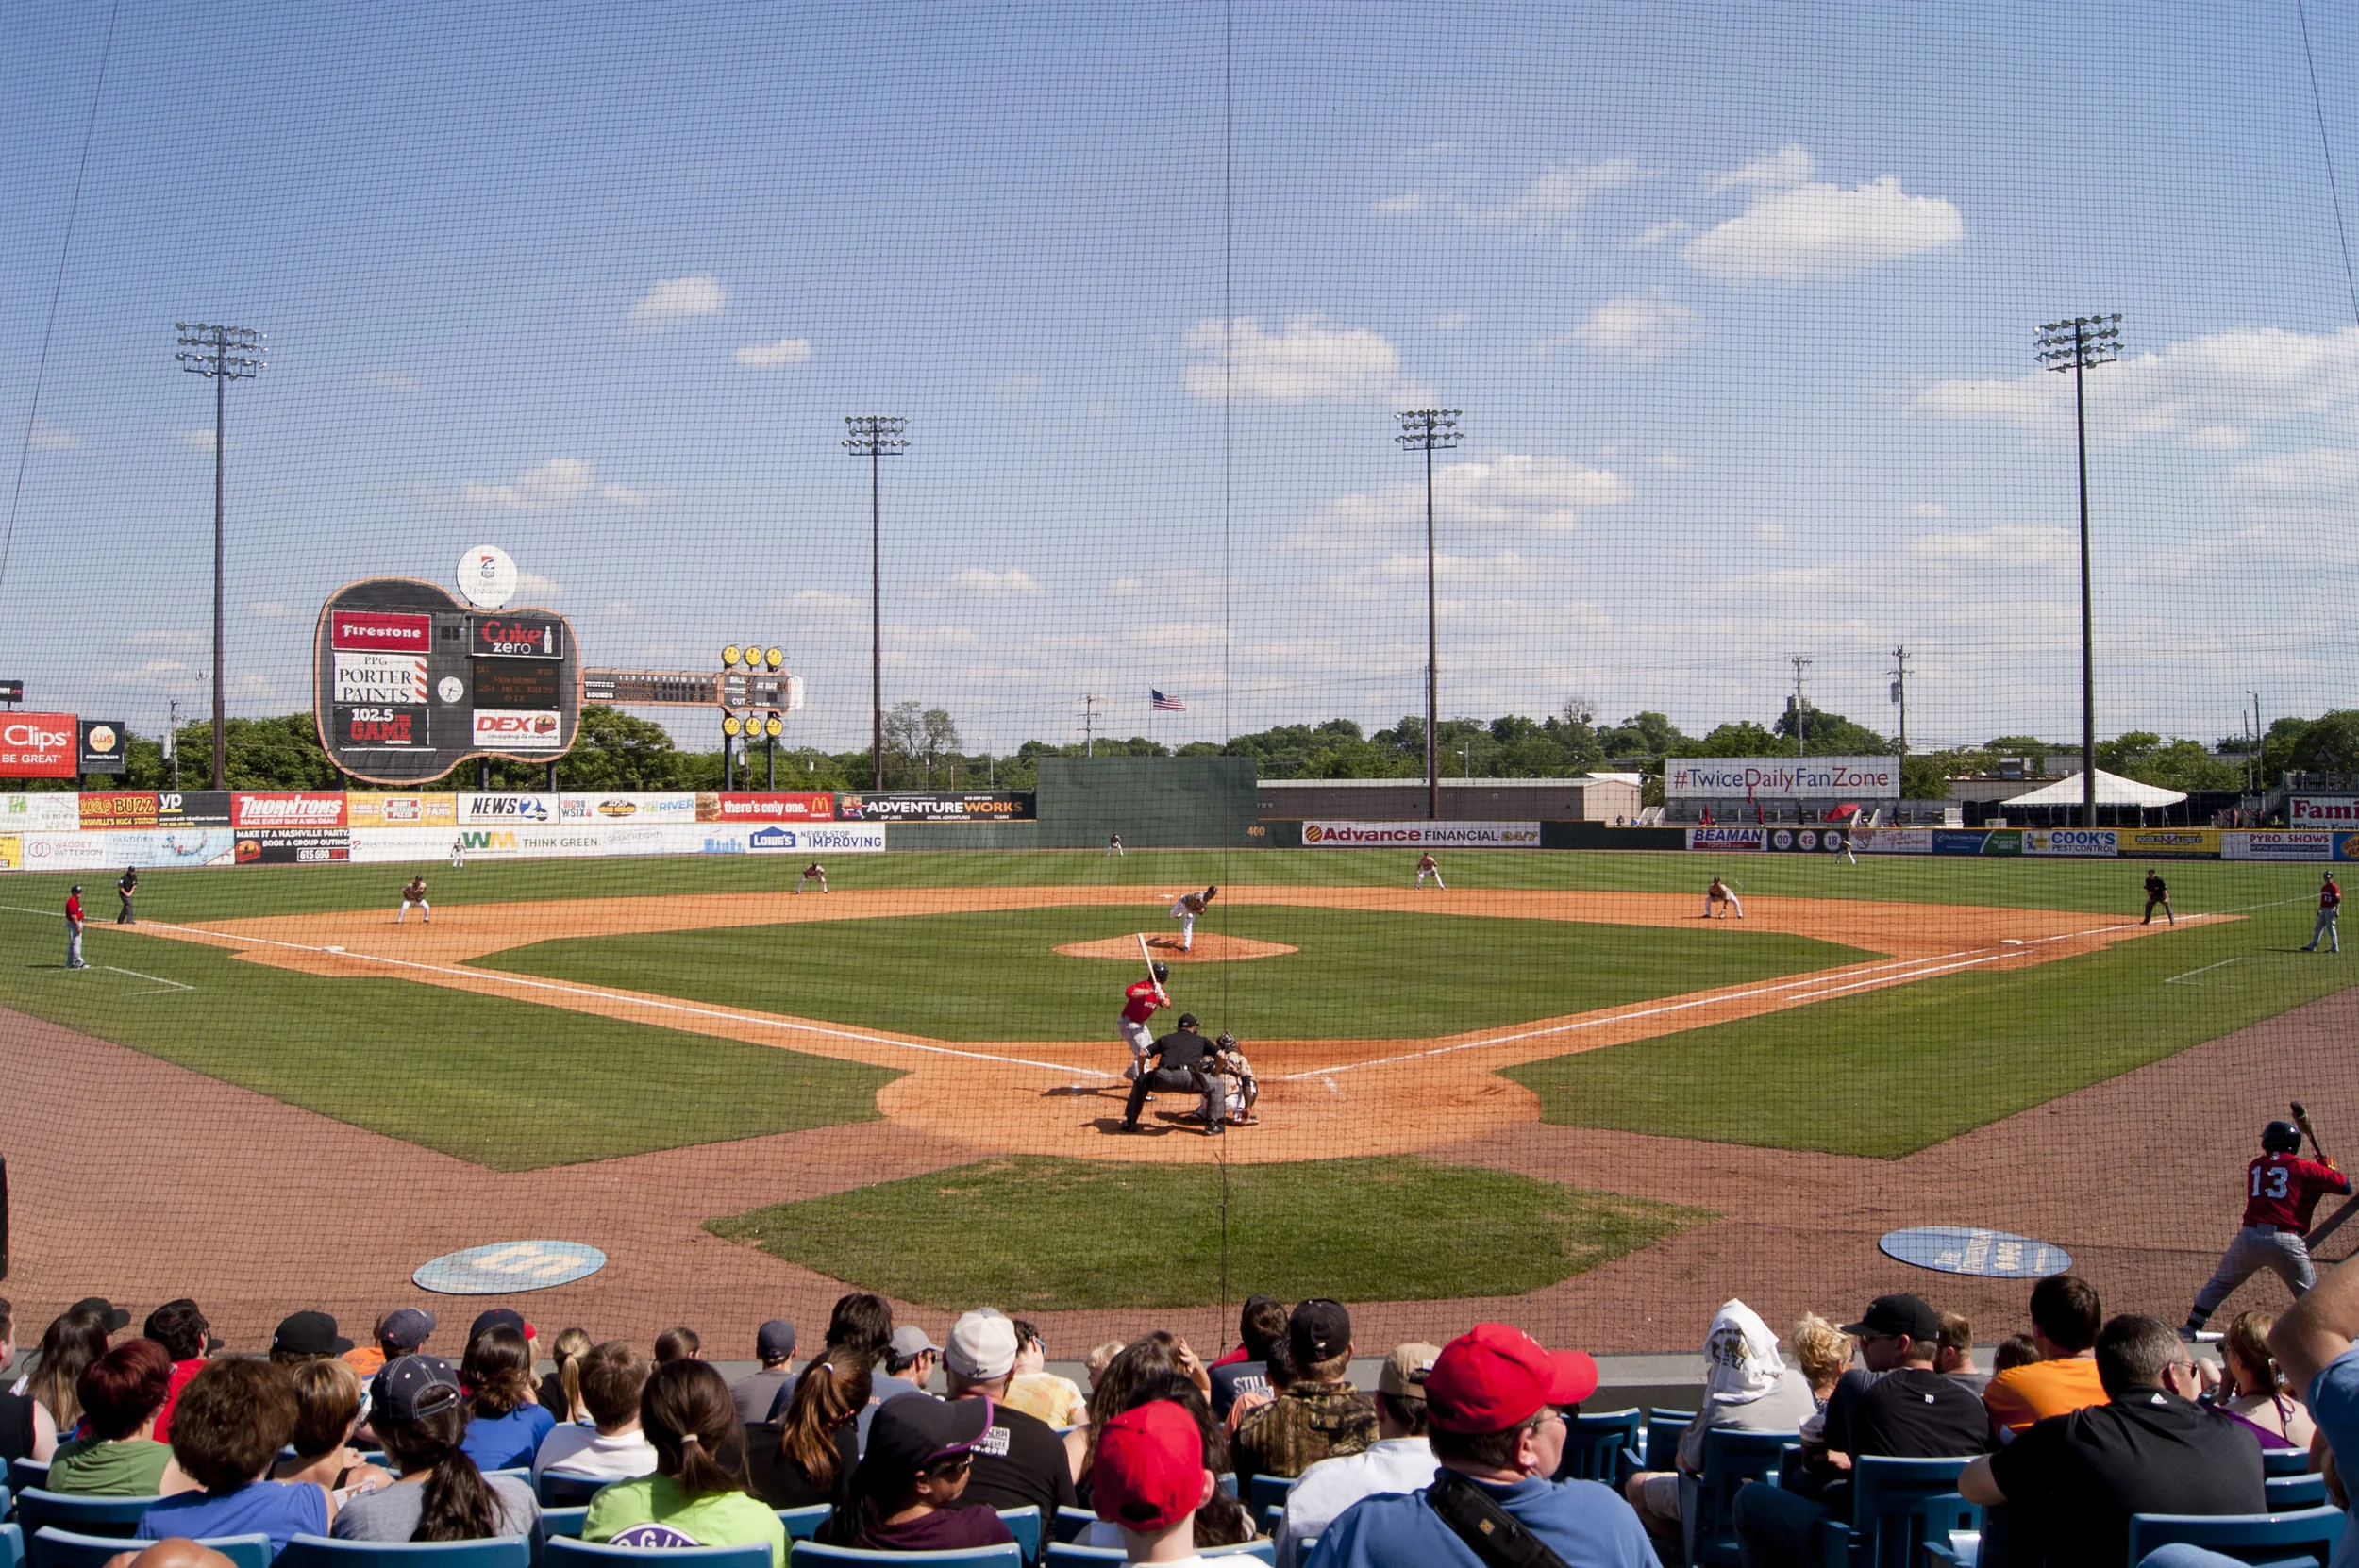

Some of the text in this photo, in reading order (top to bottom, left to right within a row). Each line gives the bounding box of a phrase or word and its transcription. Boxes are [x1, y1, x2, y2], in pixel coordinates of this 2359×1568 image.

[342, 625, 422, 638] Firestone
[481, 620, 544, 646] Coke
[493, 642, 532, 655] zero
[340, 669, 411, 684] PORTER
[729, 676, 746, 684] BALL
[343, 687, 410, 703] PAINTS
[351, 708, 393, 722] 102.5
[350, 721, 412, 740] GAME
[476, 716, 533, 732] DEX
[4, 725, 67, 752] Clips
[2, 754, 58, 763] BE GREAT
[1673, 767, 1889, 793] #TwiceDailyFanZone
[114, 798, 156, 815] BUZZ
[159, 793, 182, 809] yp
[239, 794, 343, 818] THORNTONS
[471, 797, 517, 814] NEWS
[659, 799, 694, 811] RIVER
[867, 801, 1023, 814] ADVENTUREWORKS
[427, 808, 451, 816] FANS
[561, 808, 585, 817] WSIX
[724, 800, 808, 816] there's only one.
[1246, 826, 1265, 836] 400
[1321, 827, 1538, 842] Advance FINANCIAL 24/7
[1694, 830, 1763, 841] BEAMAN
[112, 836, 154, 844] PANDORA
[523, 837, 601, 848] THINK GREEN.
[754, 835, 793, 846] LOWE'S
[809, 837, 881, 847] IMPROVING
[1777, 835, 1788, 844] 00
[1802, 836, 1814, 845] 42
[1828, 836, 1838, 845] 18
[2051, 832, 2116, 844] COOK'S
[2250, 834, 2329, 843] PYRO SHOWS
[299, 849, 314, 859] 615
[2076, 844, 2115, 853] CONTROL
[2251, 1166, 2289, 1199] 13
[1233, 1376, 1267, 1394] STILL
